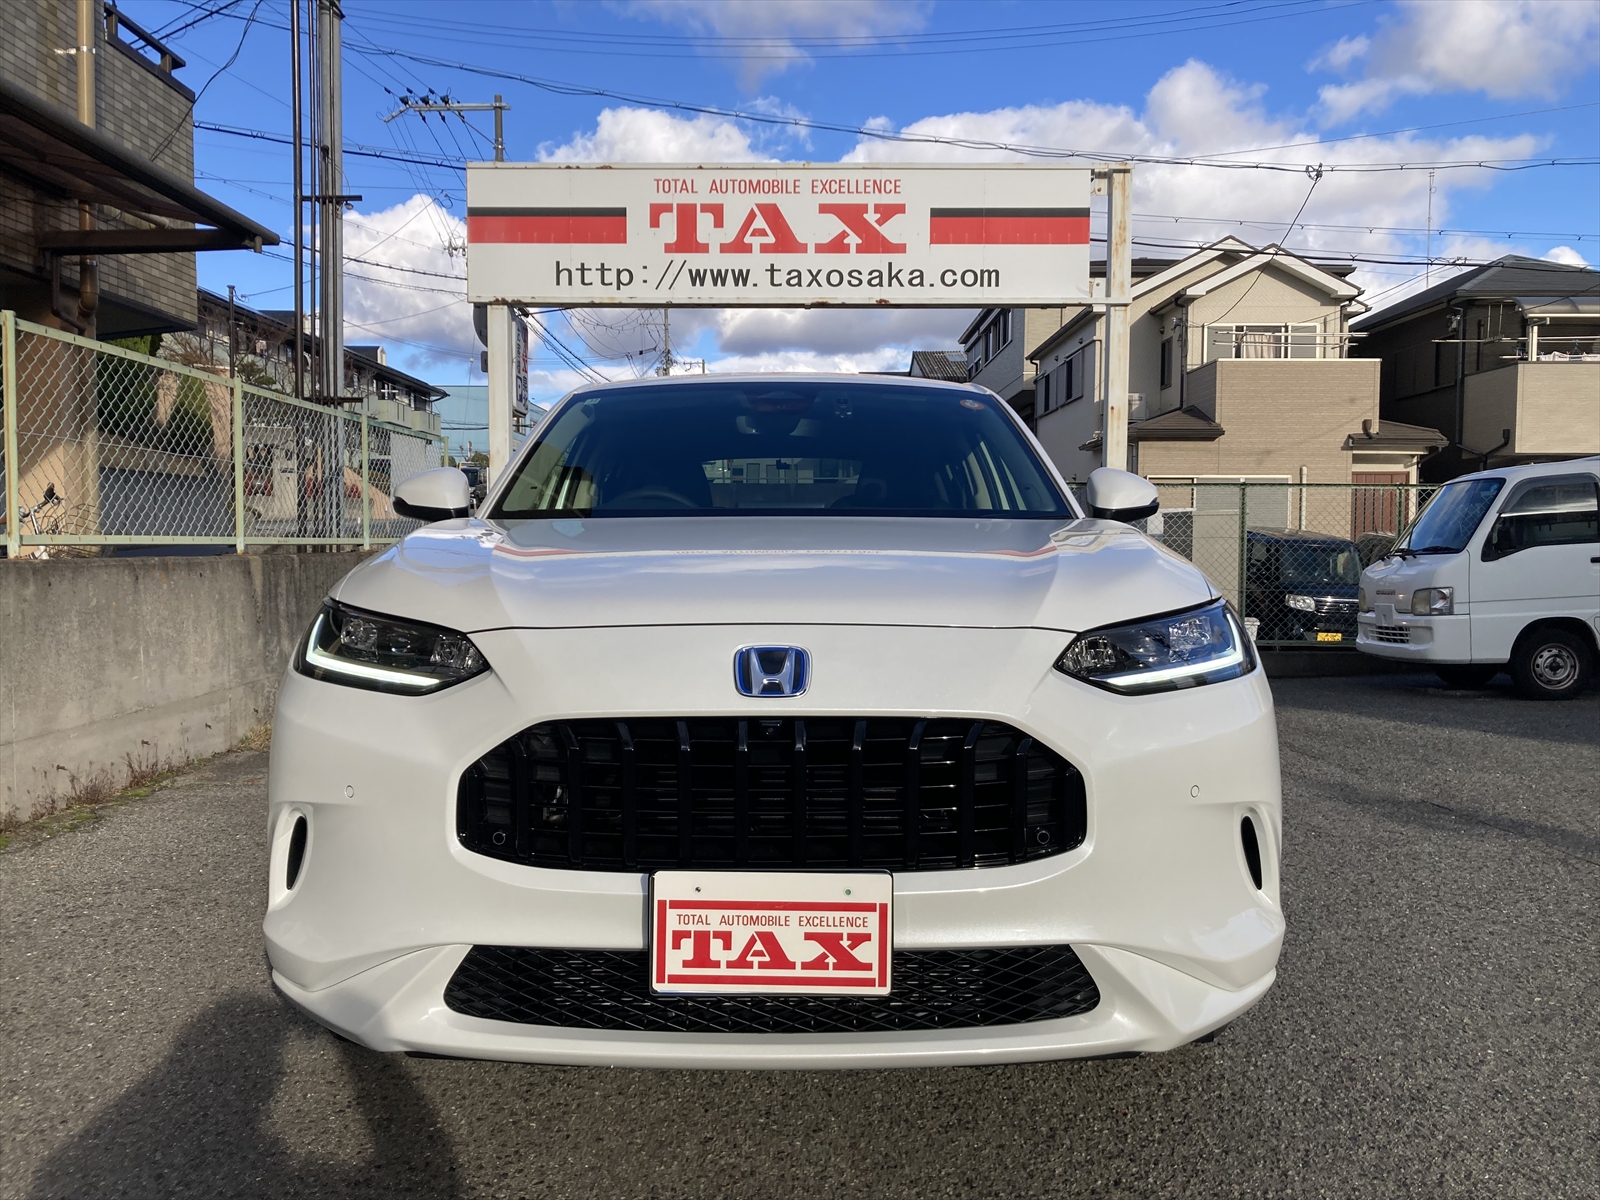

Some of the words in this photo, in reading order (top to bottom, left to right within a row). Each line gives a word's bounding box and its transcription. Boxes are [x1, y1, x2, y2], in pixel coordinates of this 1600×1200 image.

[653, 178, 698, 194] TOTAL
[709, 178, 801, 195] AUTOMOBILE
[811, 178, 902, 195] EXCELLENCE
[650, 203, 906, 254] TAX
[556, 260, 999, 290] http://www.taxosaka.com
[676, 914, 711, 926] TOTAL
[719, 914, 790, 927] AUTOMOBILE
[798, 915, 868, 928] EXCELLENCE
[672, 930, 873, 972] TAX
